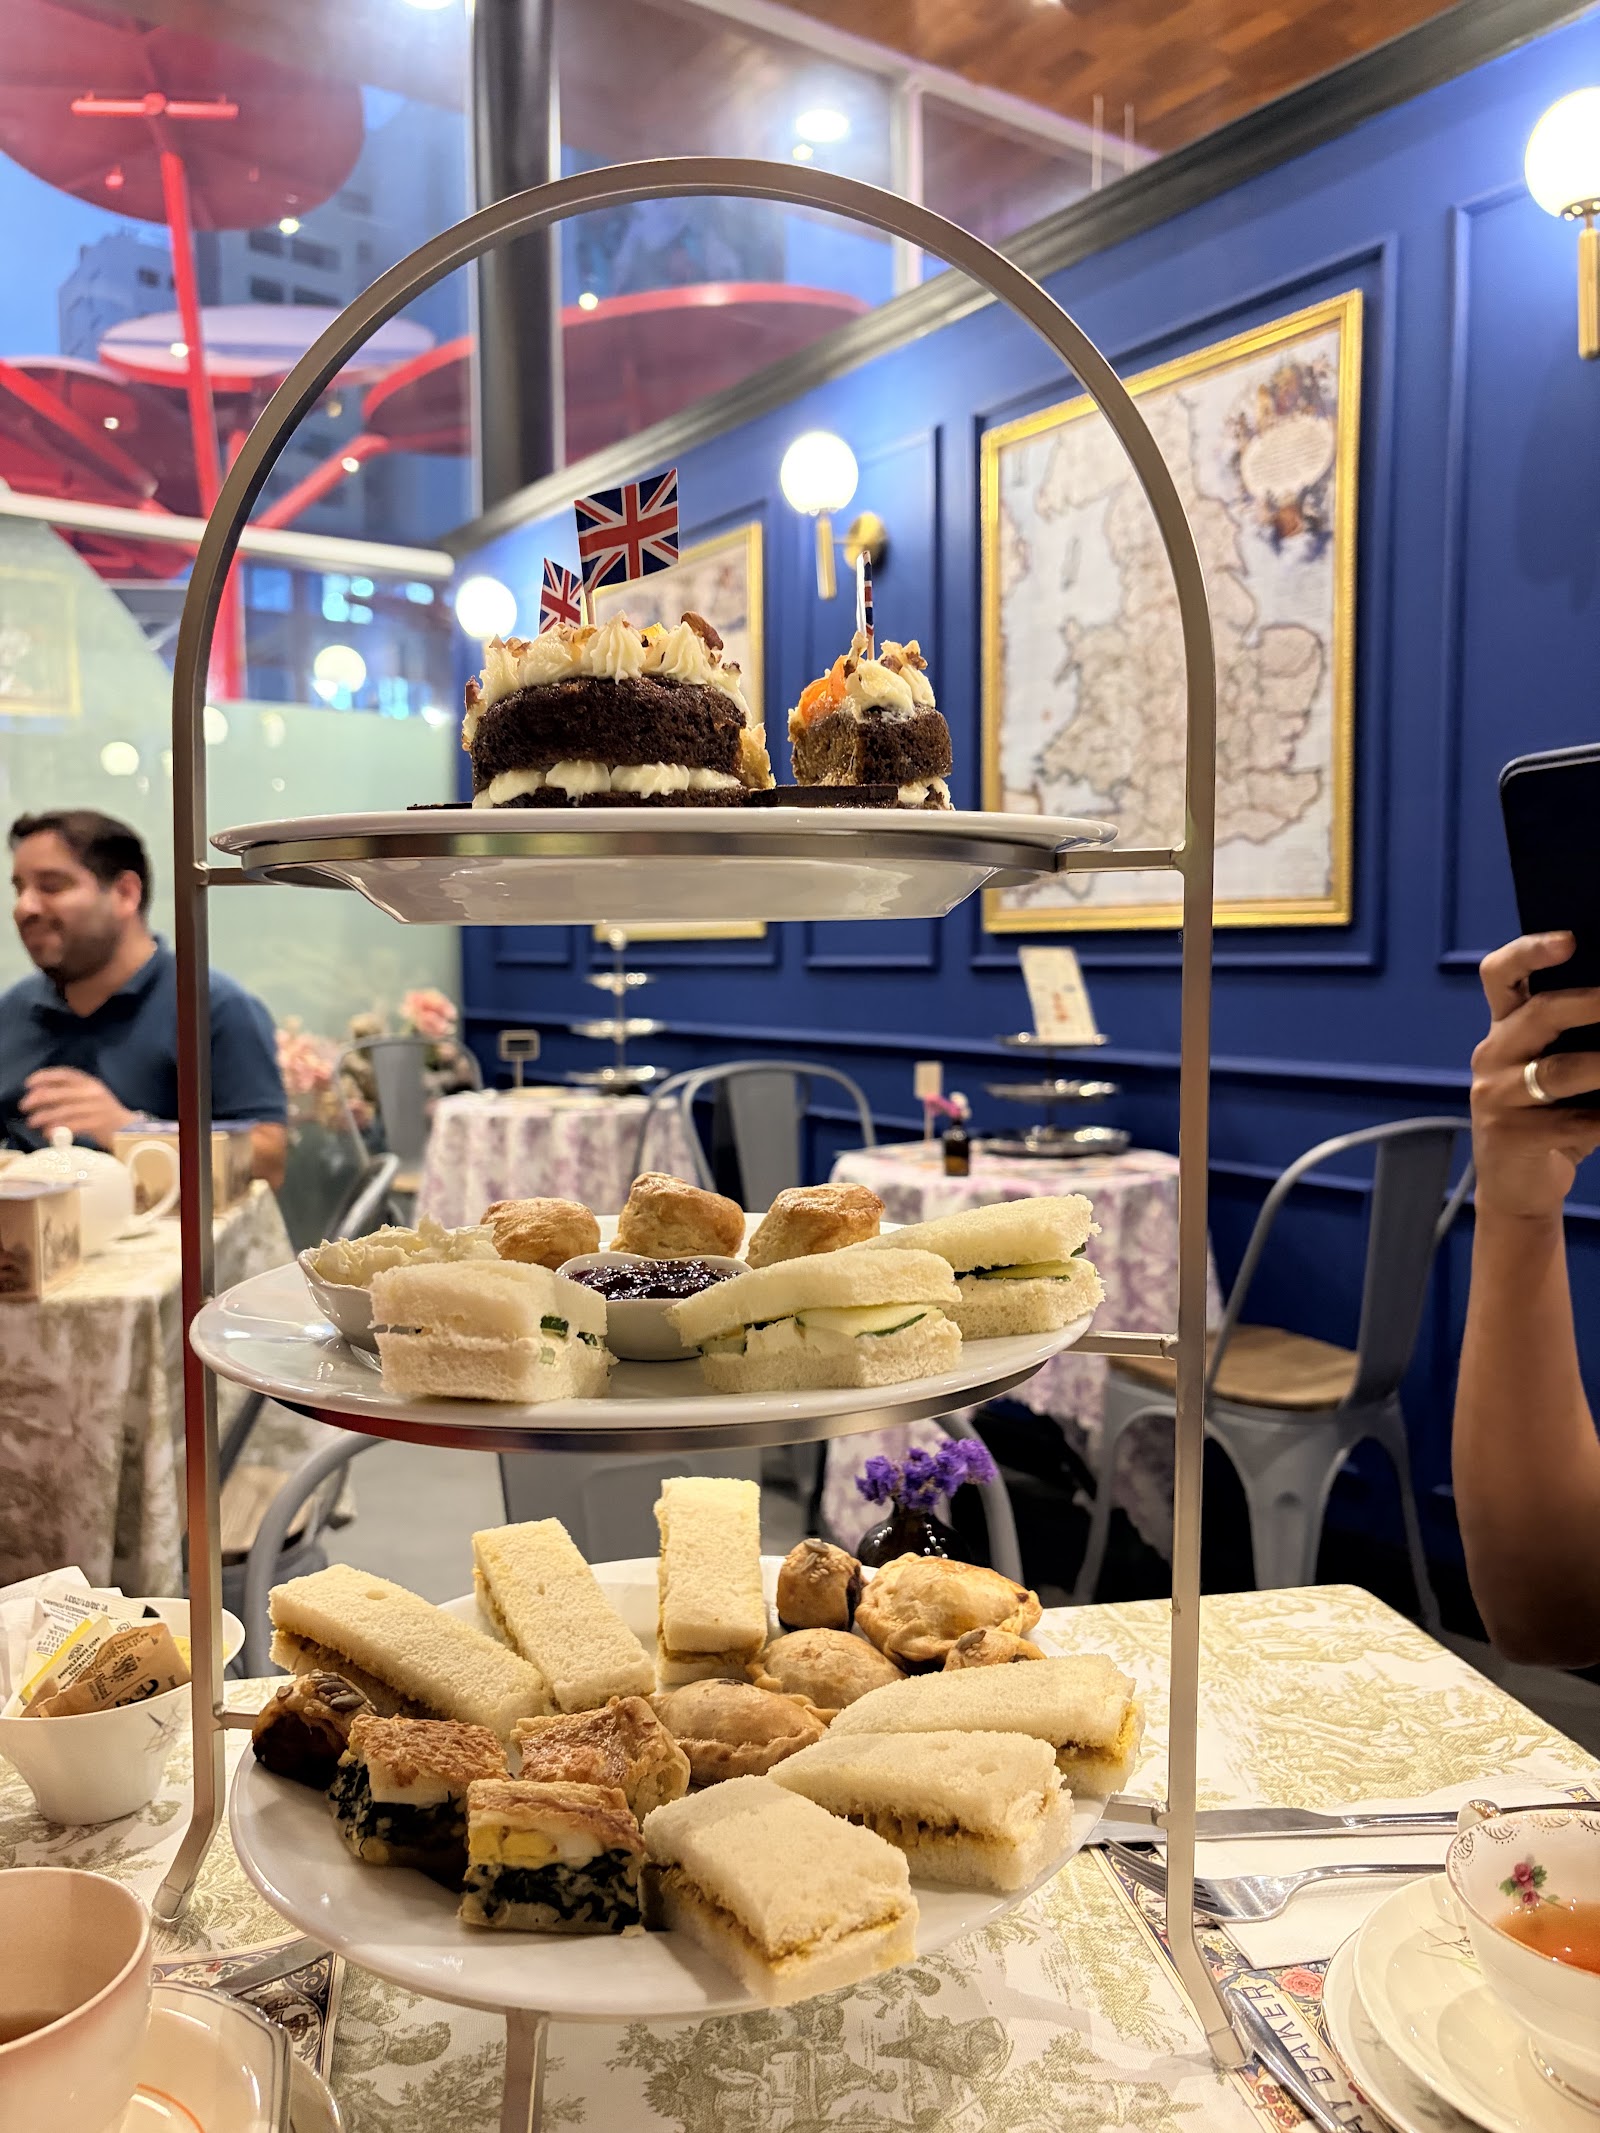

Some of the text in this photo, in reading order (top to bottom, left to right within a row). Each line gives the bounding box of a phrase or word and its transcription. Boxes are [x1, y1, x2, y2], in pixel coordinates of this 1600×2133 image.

[57, 1648, 88, 1679] ENDULZANTE
[88, 1636, 100, 1649] CON
[68, 1648, 97, 1676] SUCRALOSA
[1240, 1984, 1335, 2085] BAKER
